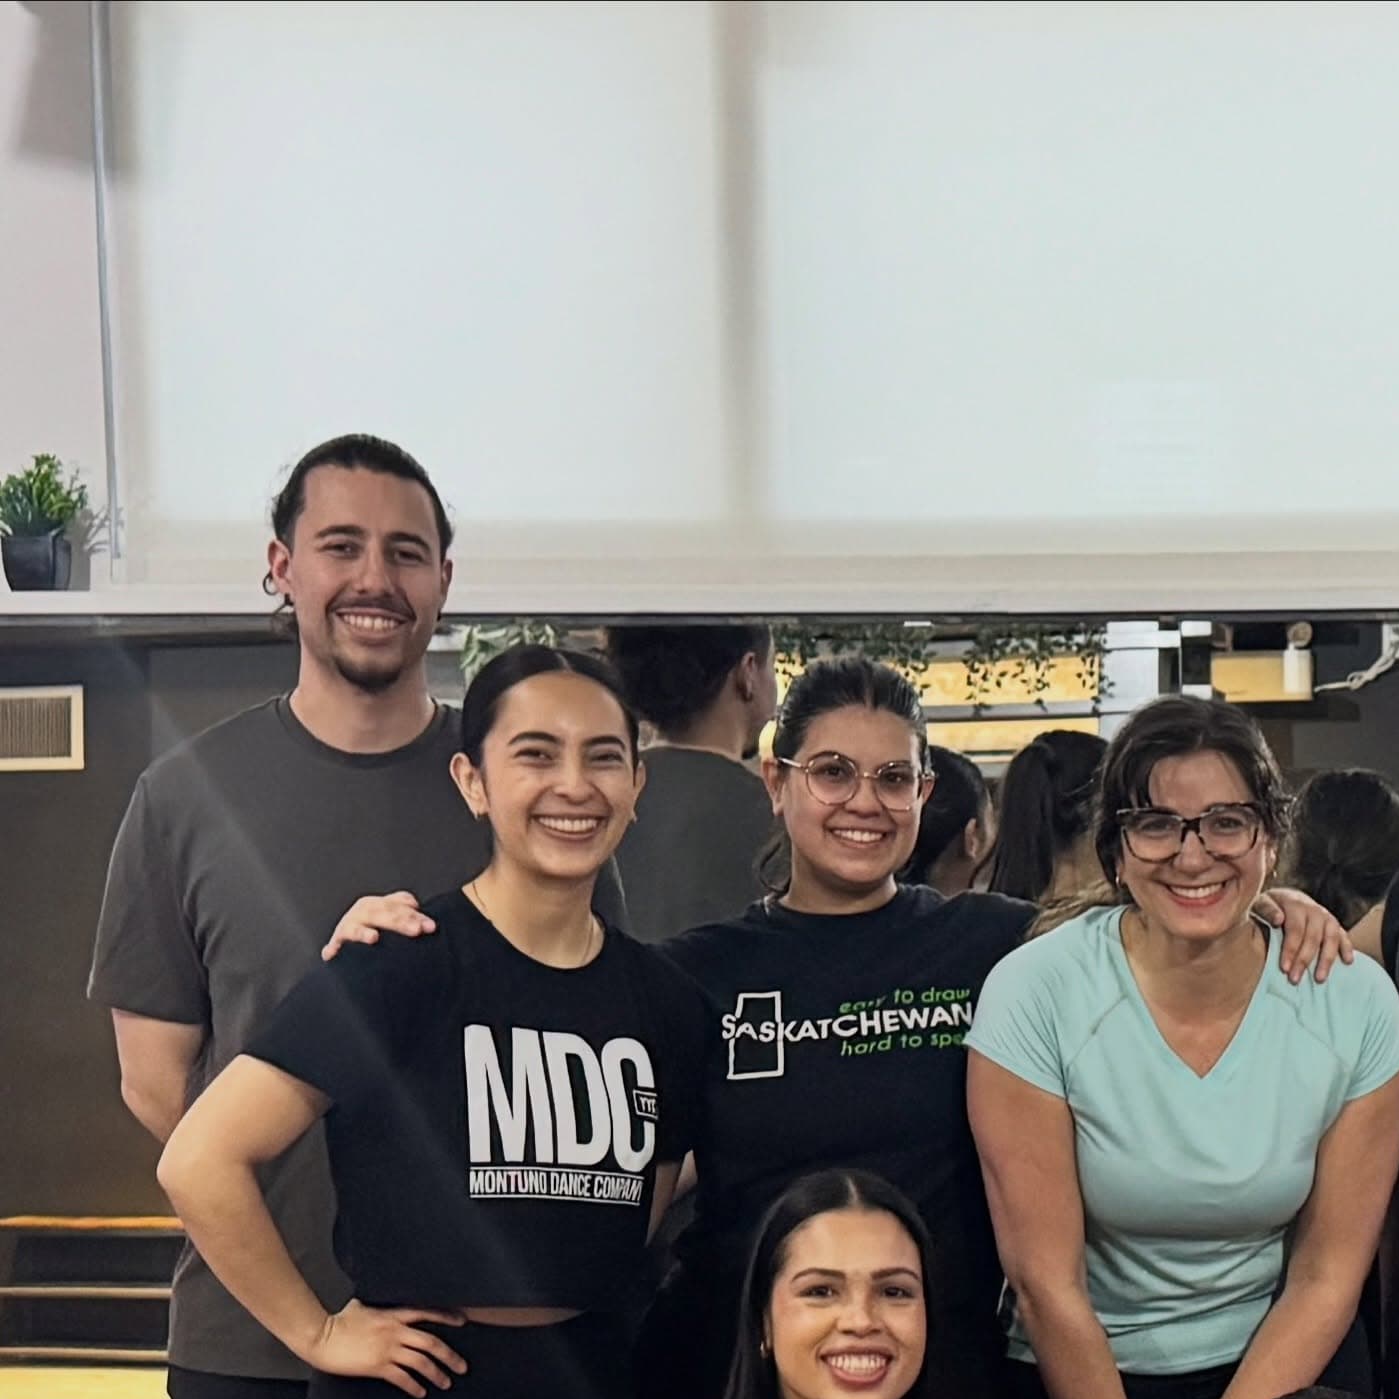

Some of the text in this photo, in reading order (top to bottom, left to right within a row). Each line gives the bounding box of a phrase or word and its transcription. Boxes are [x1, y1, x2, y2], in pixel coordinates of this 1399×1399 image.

[893, 988, 914, 1005] to
[721, 1001, 973, 1044] SASKATCHEWAN
[840, 1033, 963, 1057] hard to spe
[463, 1023, 656, 1173] MDC
[469, 1170, 547, 1195] MONTUNO
[550, 1171, 593, 1197] DANCE
